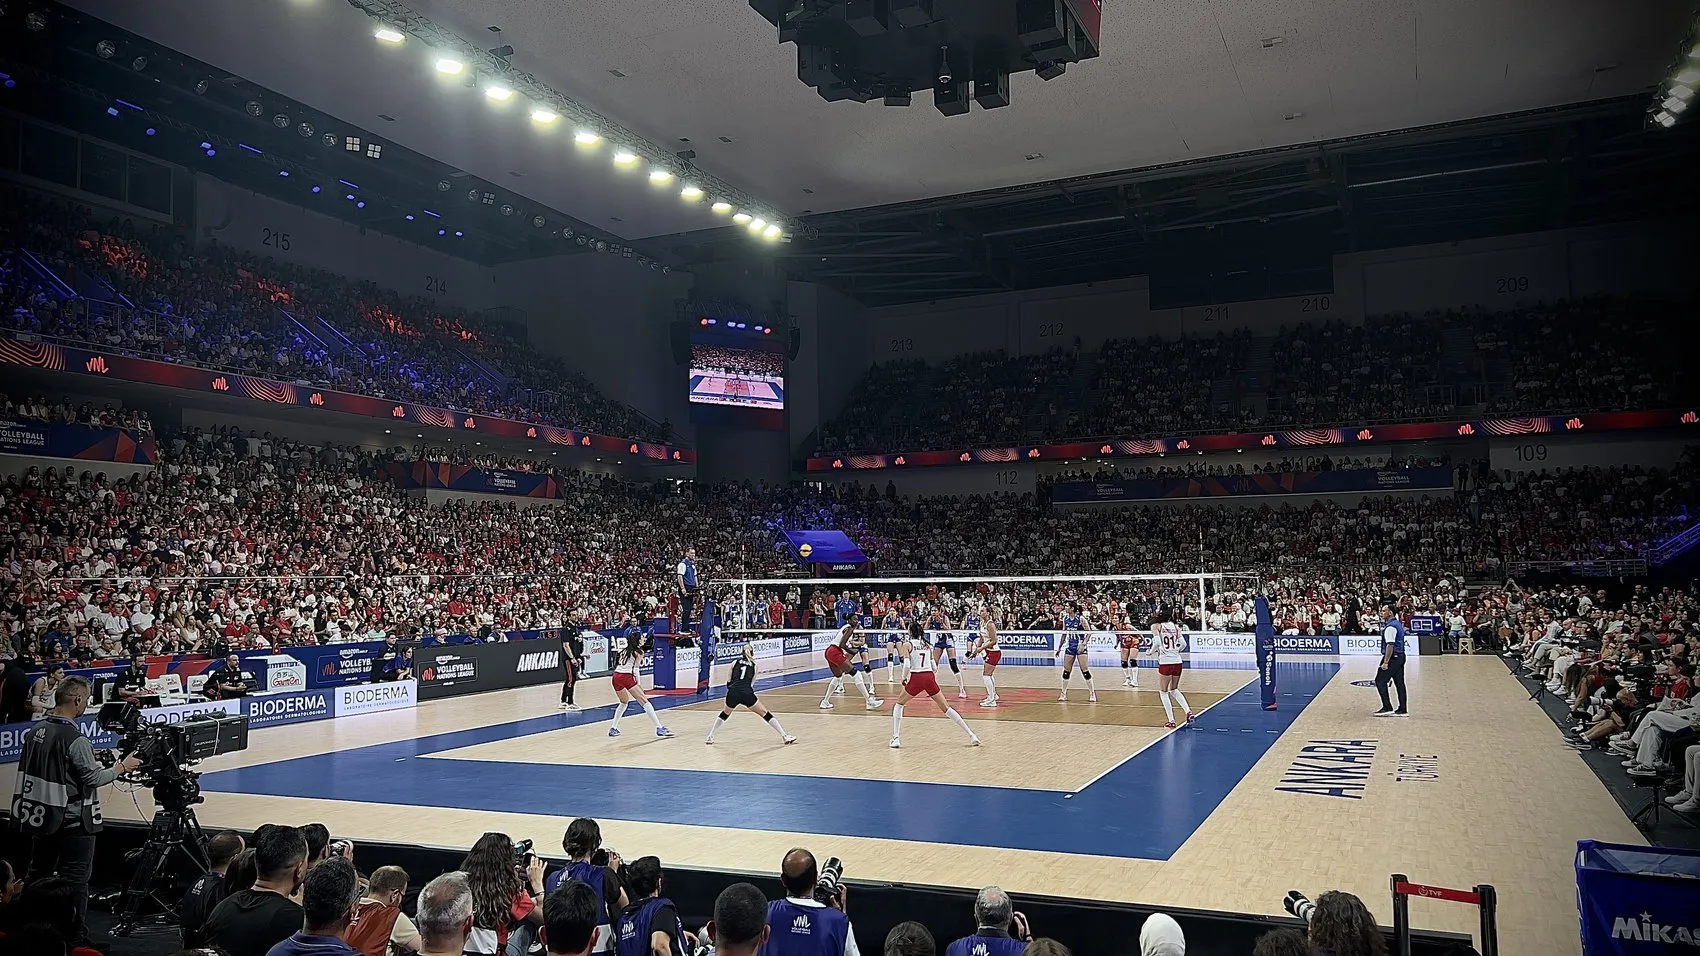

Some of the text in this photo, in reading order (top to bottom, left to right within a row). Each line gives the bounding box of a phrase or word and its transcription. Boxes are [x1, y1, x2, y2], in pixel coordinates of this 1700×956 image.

[262, 228, 290, 251] 215
[426, 275, 447, 295] 214
[1496, 276, 1529, 293] 209
[1302, 297, 1330, 312] 210
[1204, 307, 1229, 321] 211
[1040, 323, 1064, 337] 212
[890, 339, 913, 352] 213
[1514, 444, 1547, 461] 109
[995, 470, 1018, 485] 112
[997, 635, 1048, 644] BIODERMA
[1163, 636, 1176, 650] 91
[1196, 637, 1255, 646] BIODERMA
[1273, 638, 1332, 648] BIODERMA
[1347, 639, 1411, 648] BIODEA
[677, 650, 701, 662] BIODER
[717, 645, 743, 657] BIODERM
[340, 658, 373, 668] VOLLEYB
[517, 650, 559, 672] ANKARA
[919, 653, 926, 668] 7
[339, 667, 362, 675] NATIONS
[437, 663, 475, 673] VOLLEYBALL
[437, 670, 475, 680] NATIONS LEAGUE
[740, 666, 747, 680] 1
[344, 685, 409, 704] BIODERMA
[250, 695, 327, 717] BIODERMA
[250, 709, 327, 723] LABORATOIRE DERMATOLOGIQUE
[1274, 740, 1379, 799] ANKARA
[1429, 889, 1443, 897] TVF
